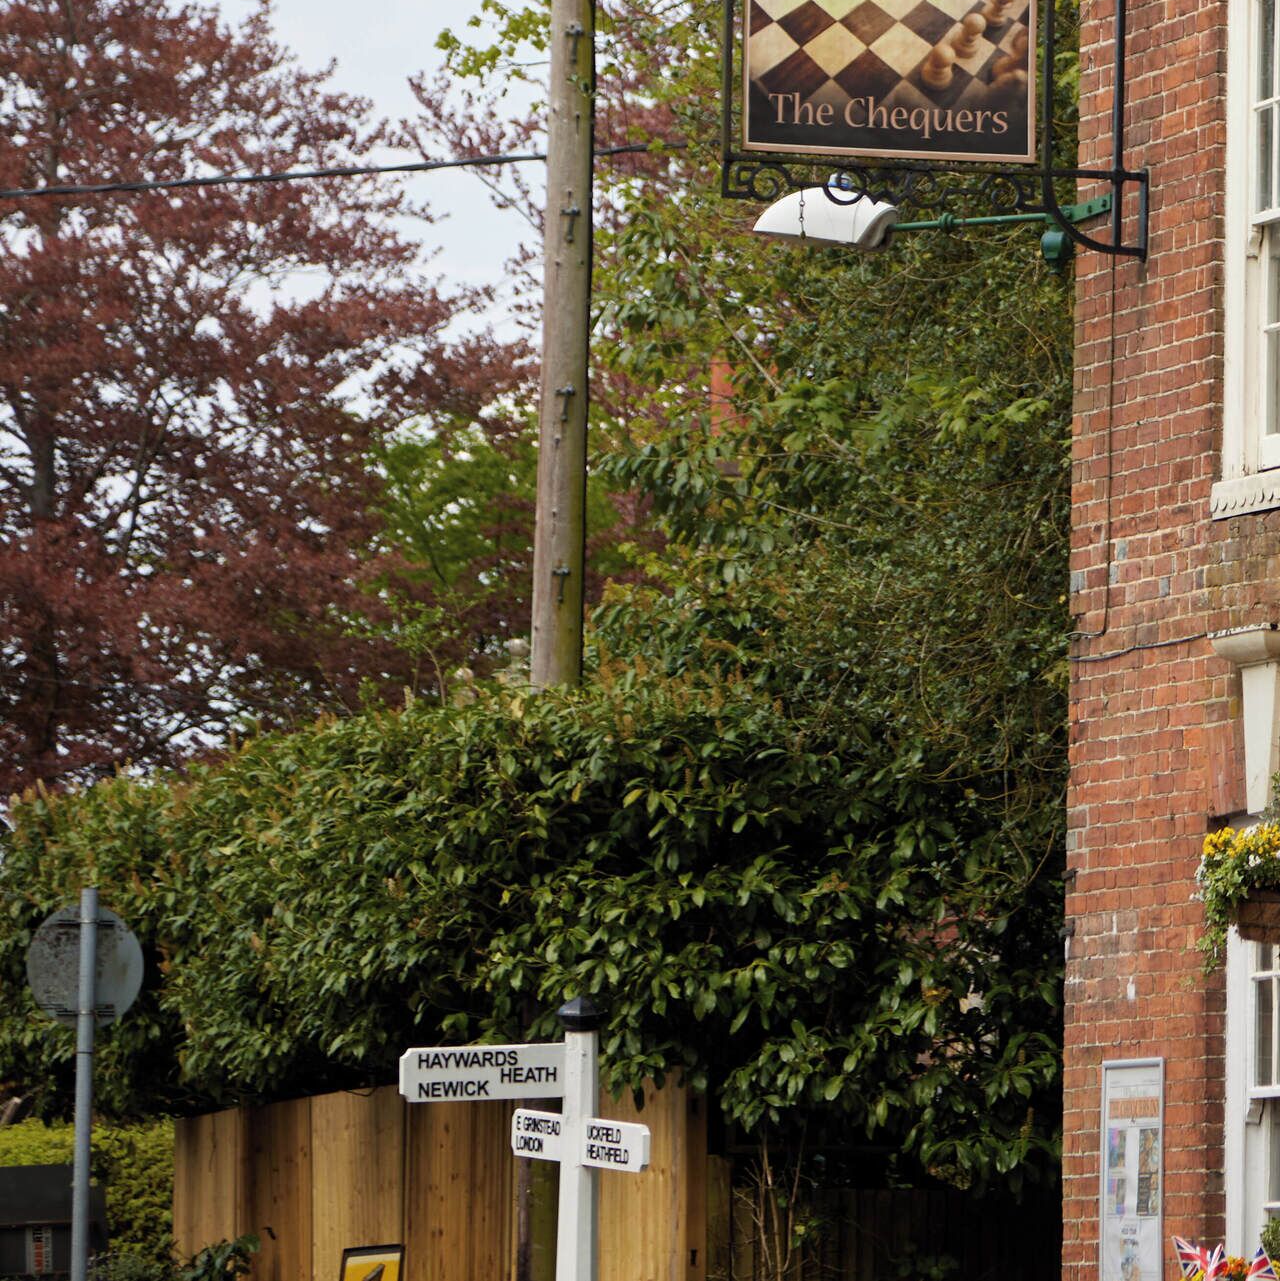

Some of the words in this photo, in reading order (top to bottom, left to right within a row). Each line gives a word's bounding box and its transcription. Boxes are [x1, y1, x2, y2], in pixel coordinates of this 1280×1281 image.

[768, 93, 834, 126] The
[844, 96, 1009, 140] Chequers
[418, 1050, 518, 1069] HAYWARDS
[500, 1067, 557, 1083] HEATH
[418, 1080, 489, 1098] NEWICK
[516, 1115, 521, 1130] E
[524, 1116, 561, 1136] GRINSTEAD
[586, 1125, 621, 1144] UCKFIELD
[515, 1135, 543, 1152] LONDON
[586, 1144, 629, 1165] HEATHFIELD
